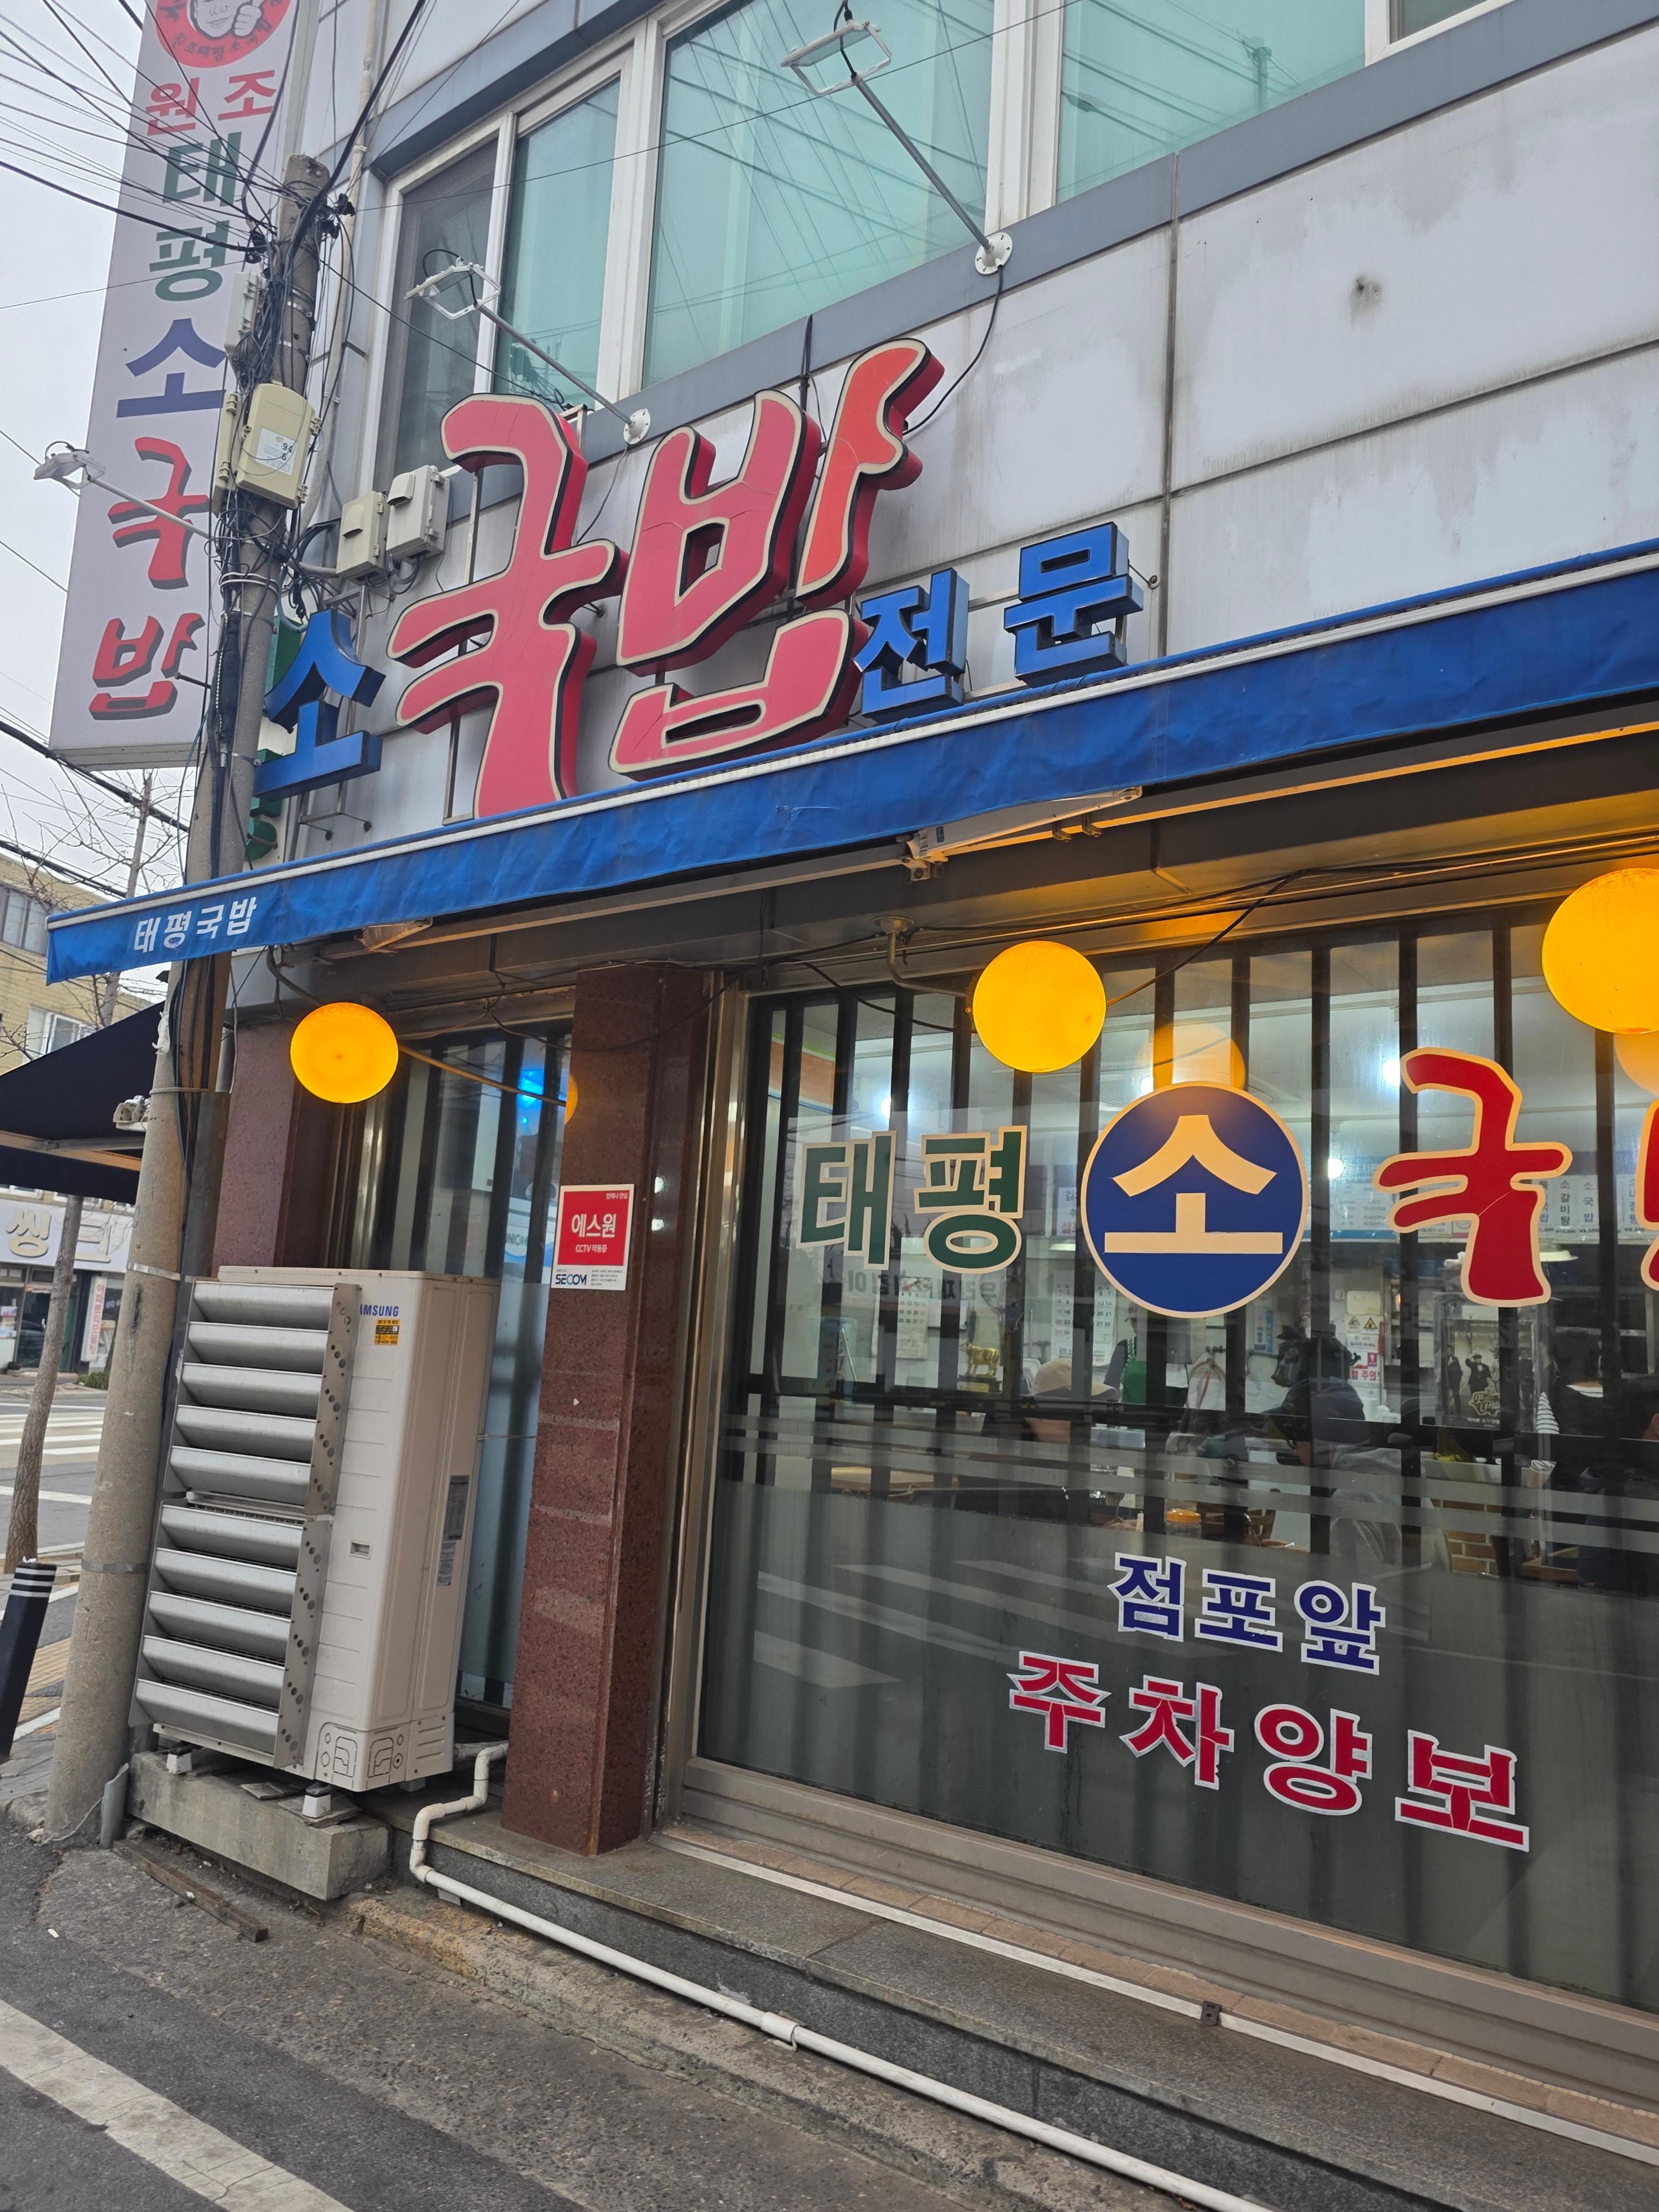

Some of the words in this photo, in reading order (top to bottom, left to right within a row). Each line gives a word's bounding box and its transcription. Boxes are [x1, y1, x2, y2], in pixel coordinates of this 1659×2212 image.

[146, 70, 277, 137] 원조
[387, 338, 943, 820] 국밥
[853, 521, 1143, 722] 전문
[134, 896, 257, 953] 태평국밥
[796, 1125, 1027, 1274] 태평
[1104, 1114, 1283, 1254] 소
[1559, 1180, 1571, 1226] 소갈비탕
[571, 1213, 617, 1238] 에스원
[592, 1245, 607, 1253] 작동중
[555, 1274, 587, 1286] SECOM
[1107, 1552, 1386, 1675] 점포앞
[1006, 1650, 1530, 1852] 주차양보
